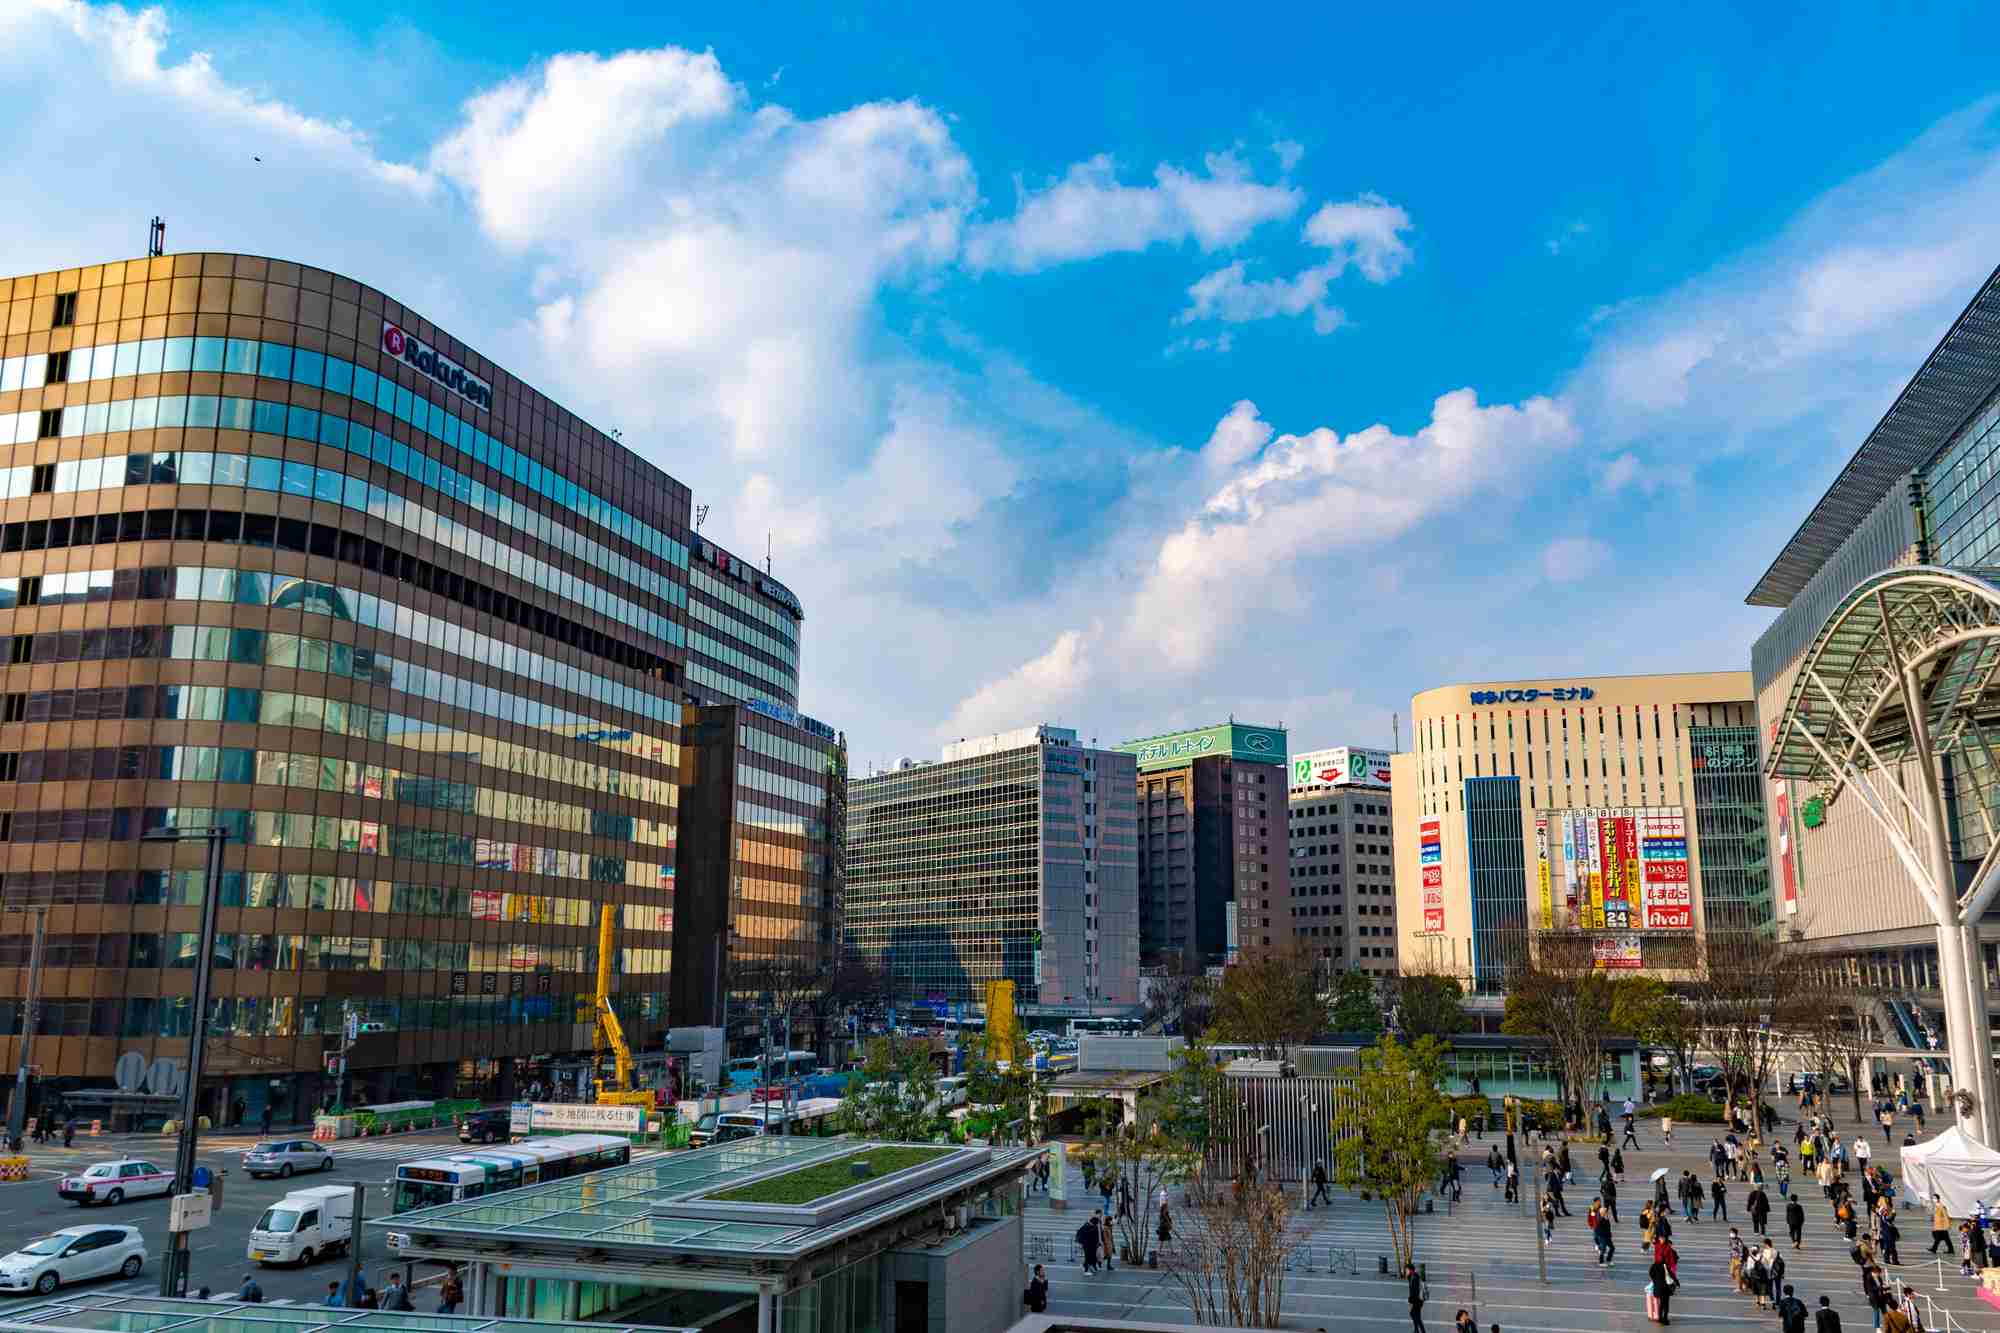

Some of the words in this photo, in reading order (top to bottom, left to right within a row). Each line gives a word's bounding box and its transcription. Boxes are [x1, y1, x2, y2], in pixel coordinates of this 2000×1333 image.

[405, 336, 490, 408] Rakuten
[1649, 865, 1685, 873] DAISO
[1648, 888, 1688, 900] しまむら
[1607, 912, 1627, 922] 24
[1650, 911, 1688, 926] Avail
